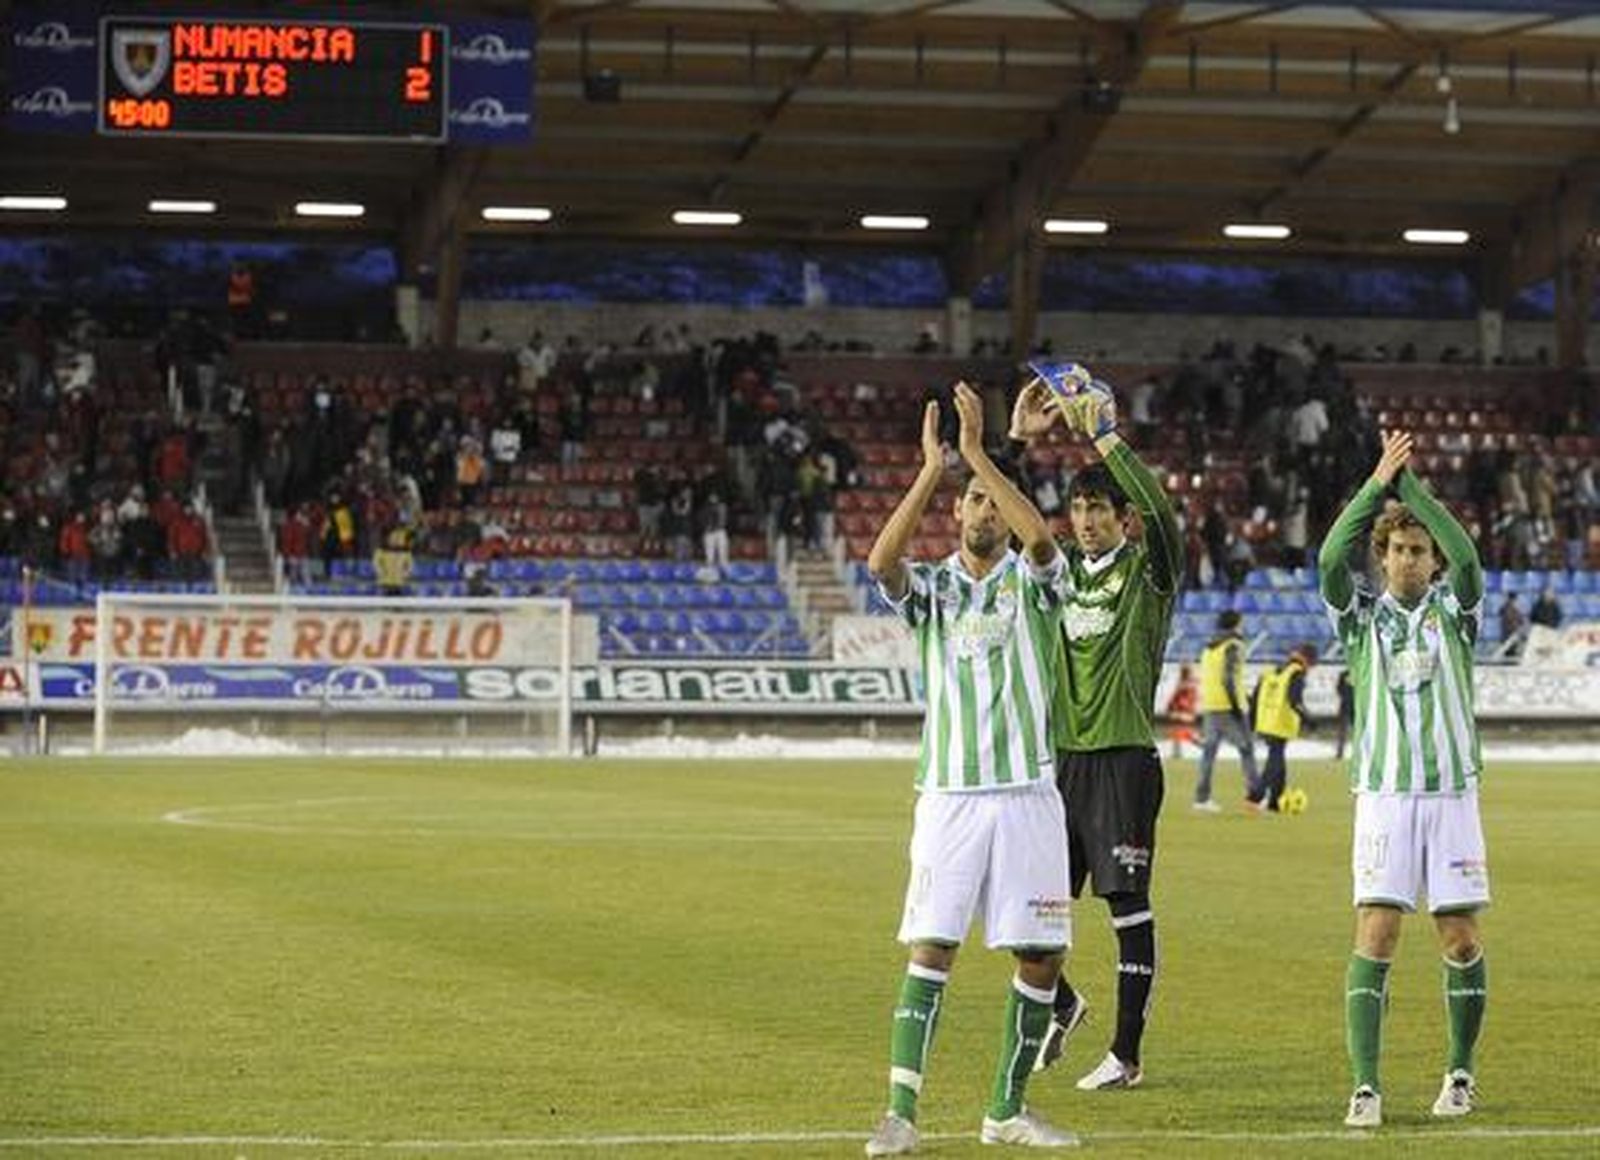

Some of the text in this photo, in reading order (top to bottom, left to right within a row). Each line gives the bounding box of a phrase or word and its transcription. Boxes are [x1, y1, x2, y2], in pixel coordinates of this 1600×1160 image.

[174, 23, 354, 62] NUMANCIA
[420, 29, 432, 64] 1
[173, 60, 431, 101] BETIS 2
[68, 615, 273, 659] FRENTE
